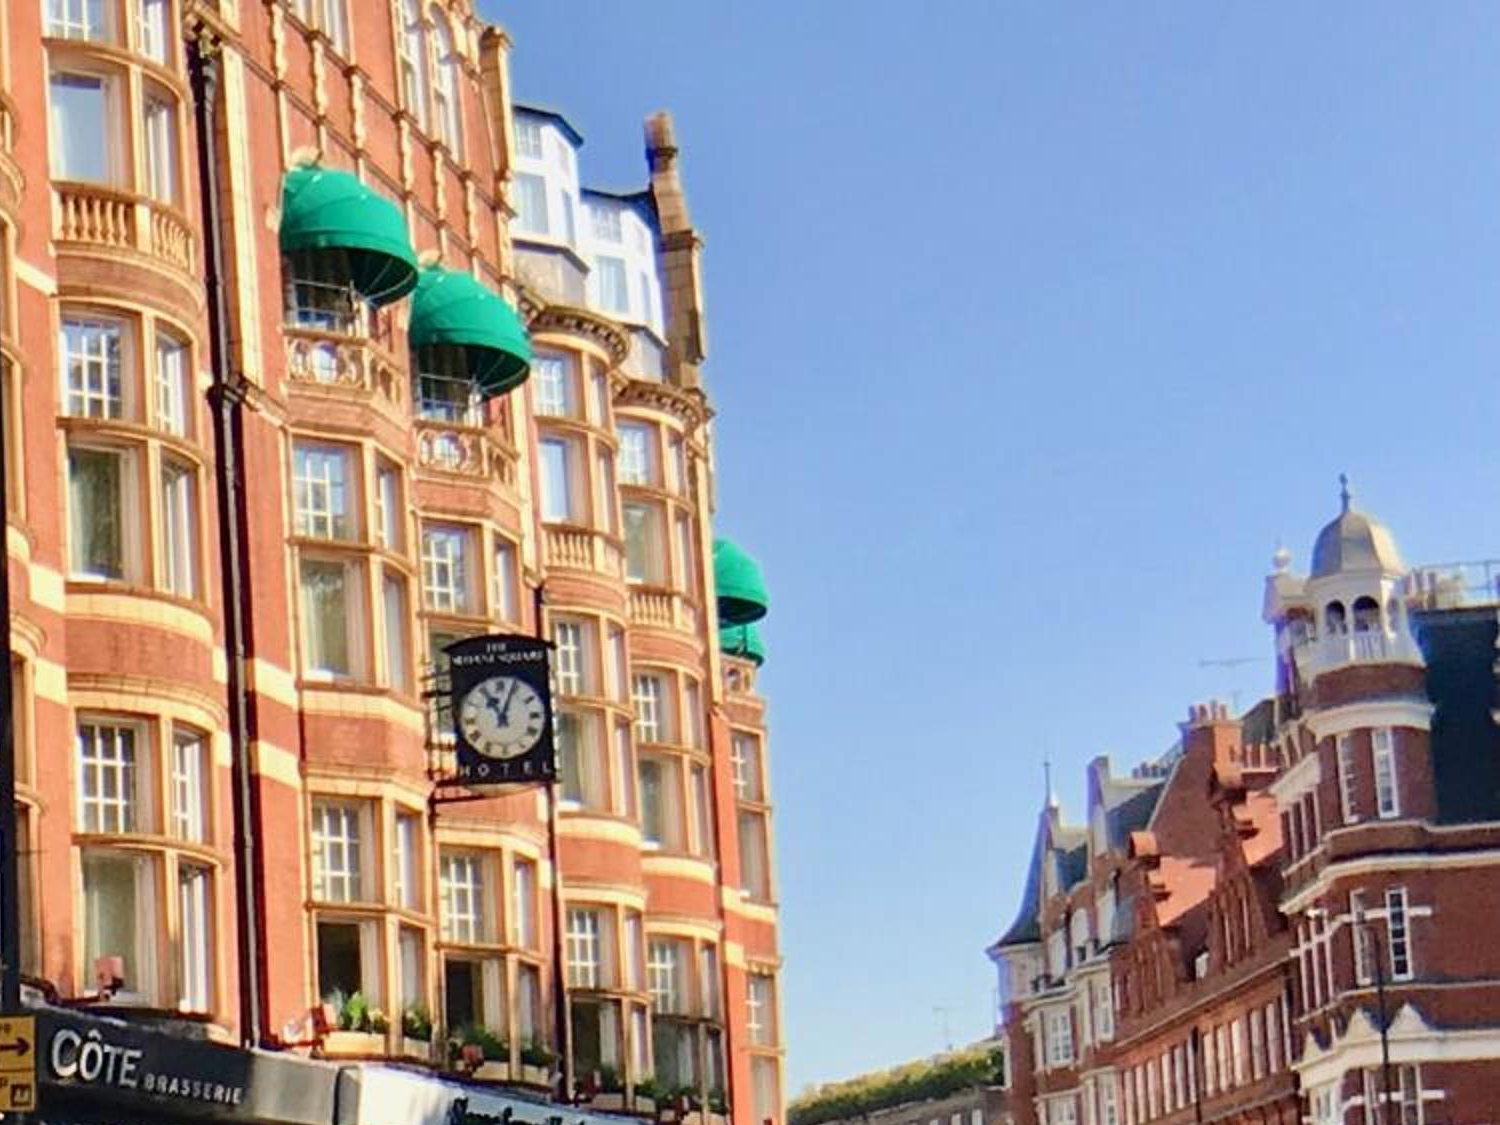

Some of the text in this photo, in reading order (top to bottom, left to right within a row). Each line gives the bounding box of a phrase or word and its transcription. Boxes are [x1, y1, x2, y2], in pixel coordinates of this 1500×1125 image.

[460, 761, 551, 778] HOTEL
[51, 1027, 243, 1105] CÔTE BRASSERIE
